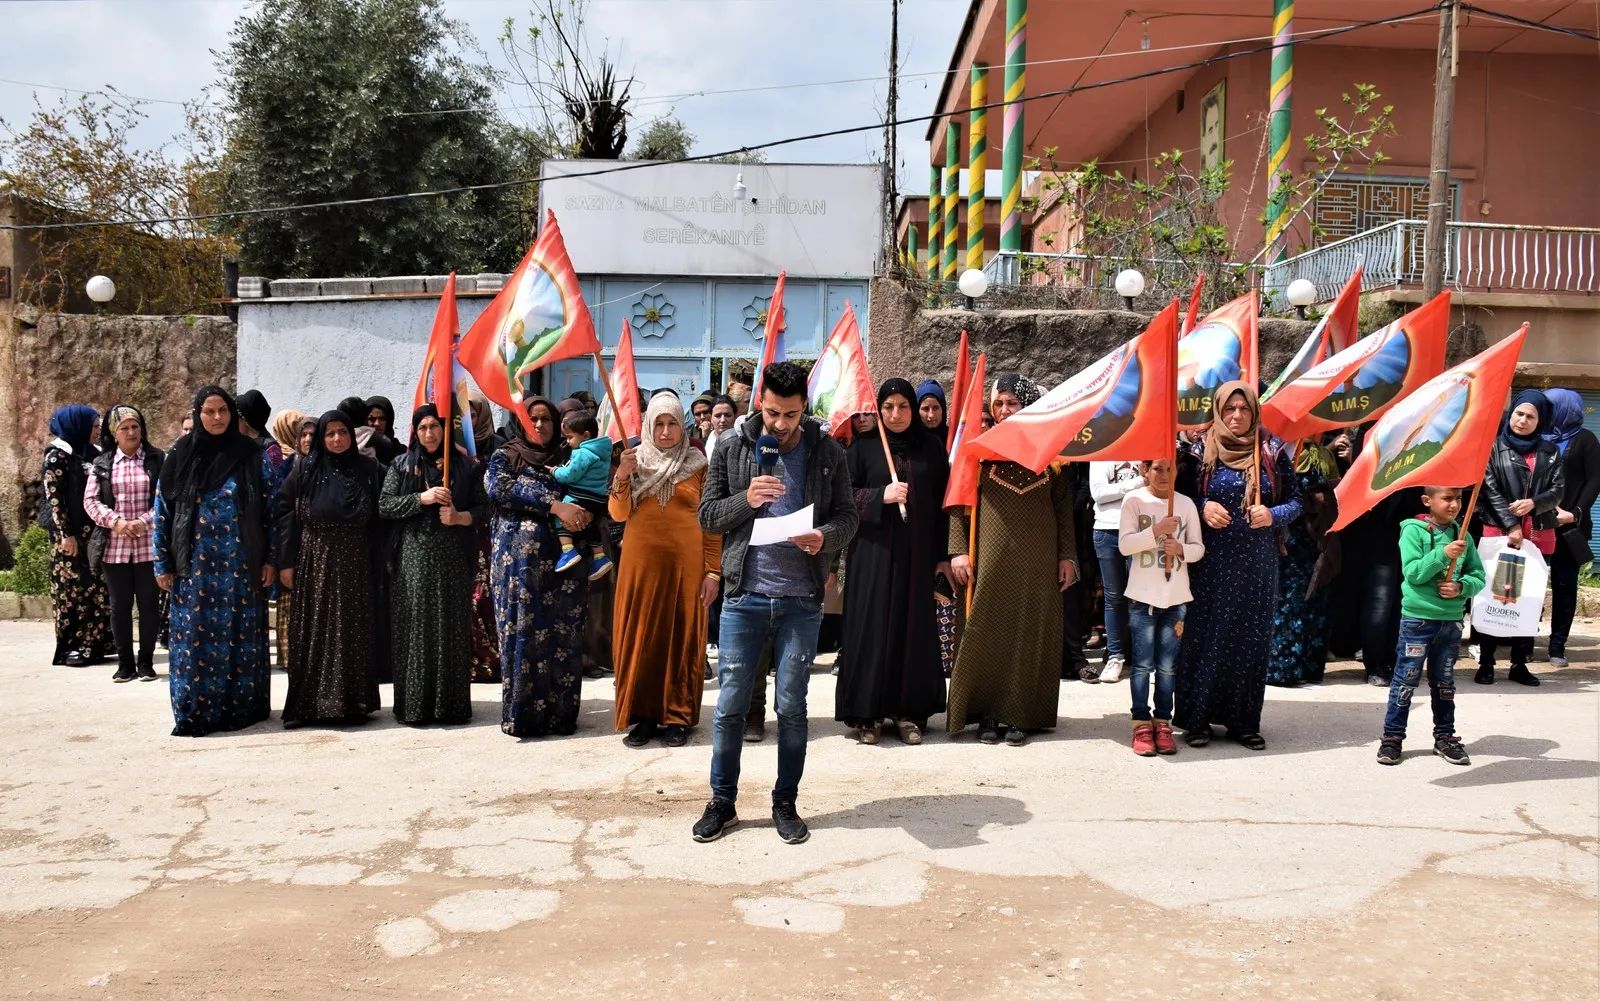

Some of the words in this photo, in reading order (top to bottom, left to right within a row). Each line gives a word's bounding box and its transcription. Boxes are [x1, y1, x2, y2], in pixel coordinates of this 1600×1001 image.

[565, 194, 624, 210] SAZIYA
[633, 191, 736, 212] MALBATÊN
[742, 193, 826, 216] ŞEHÎDAN
[643, 221, 766, 246] SERÊKANIYÊ
[1331, 395, 1370, 413] M.M.Ş
